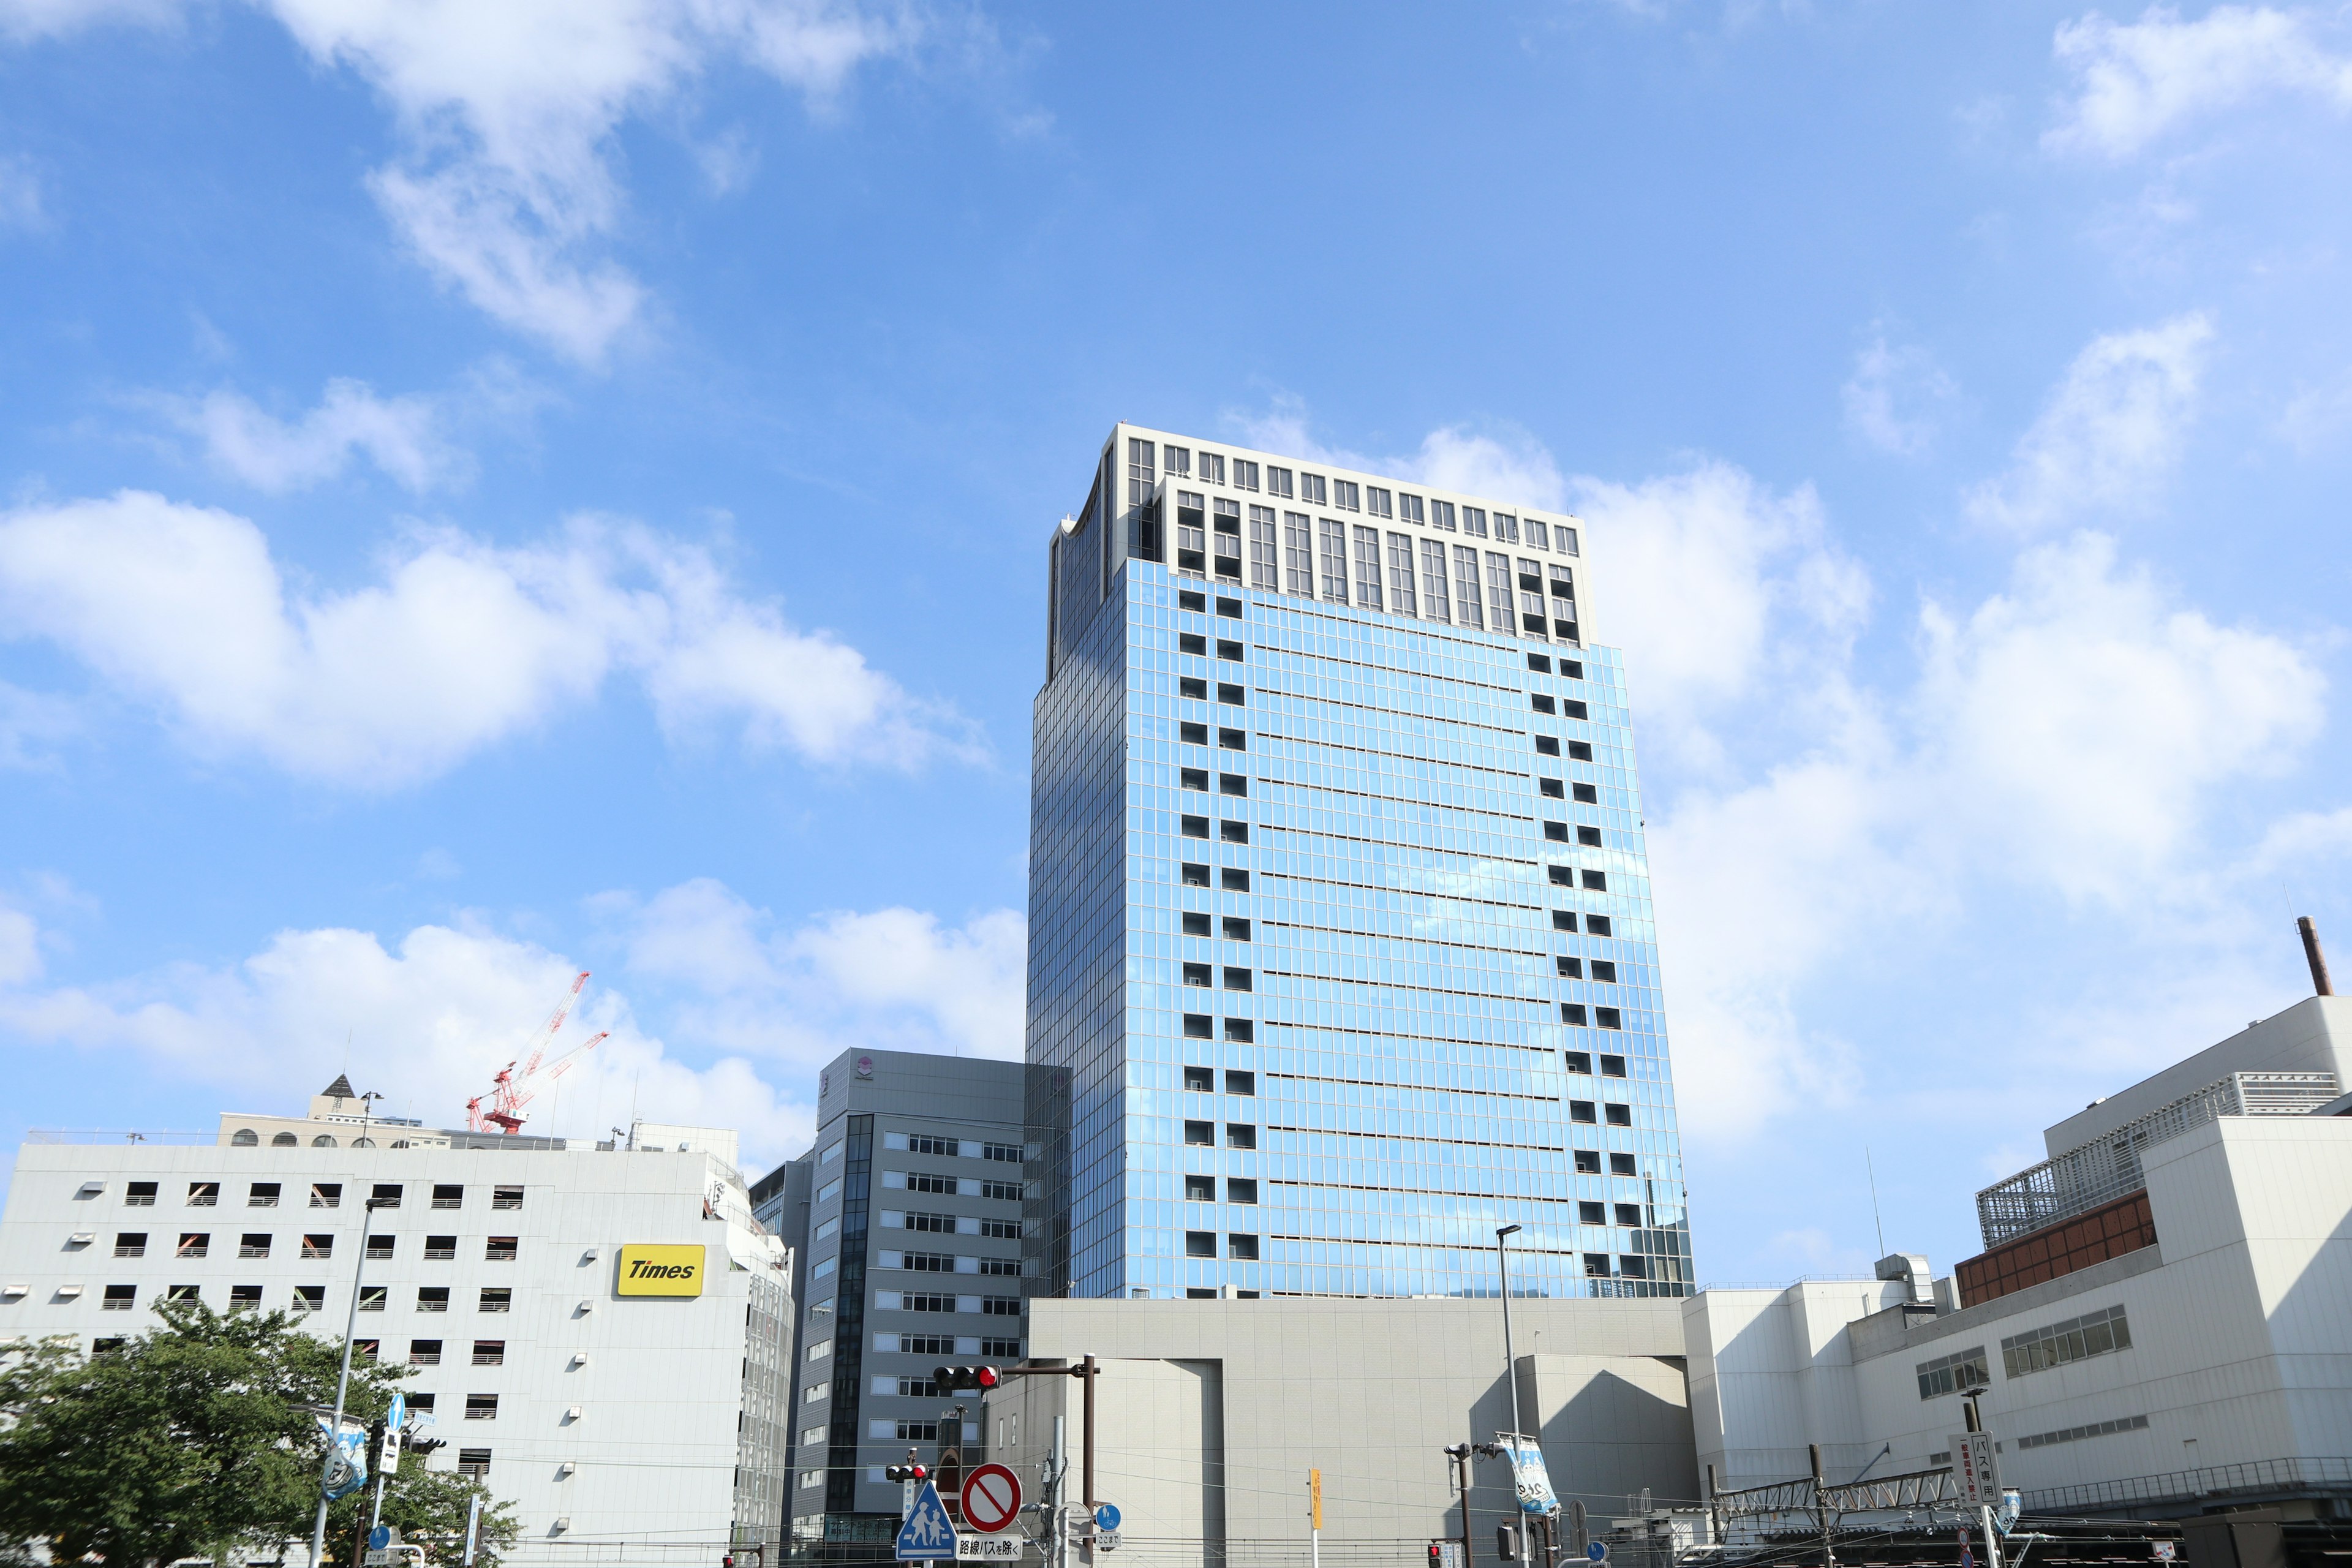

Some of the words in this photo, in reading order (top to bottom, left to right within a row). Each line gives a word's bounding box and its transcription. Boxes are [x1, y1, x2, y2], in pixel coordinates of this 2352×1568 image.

[629, 1261, 695, 1279] Times
[1960, 1439, 1977, 1502] 一般車両進入禁止
[1976, 1441, 1994, 1496] バス専用
[960, 1540, 1018, 1555] 路線バスを除く
[1098, 1536, 1118, 1544] ここまで
